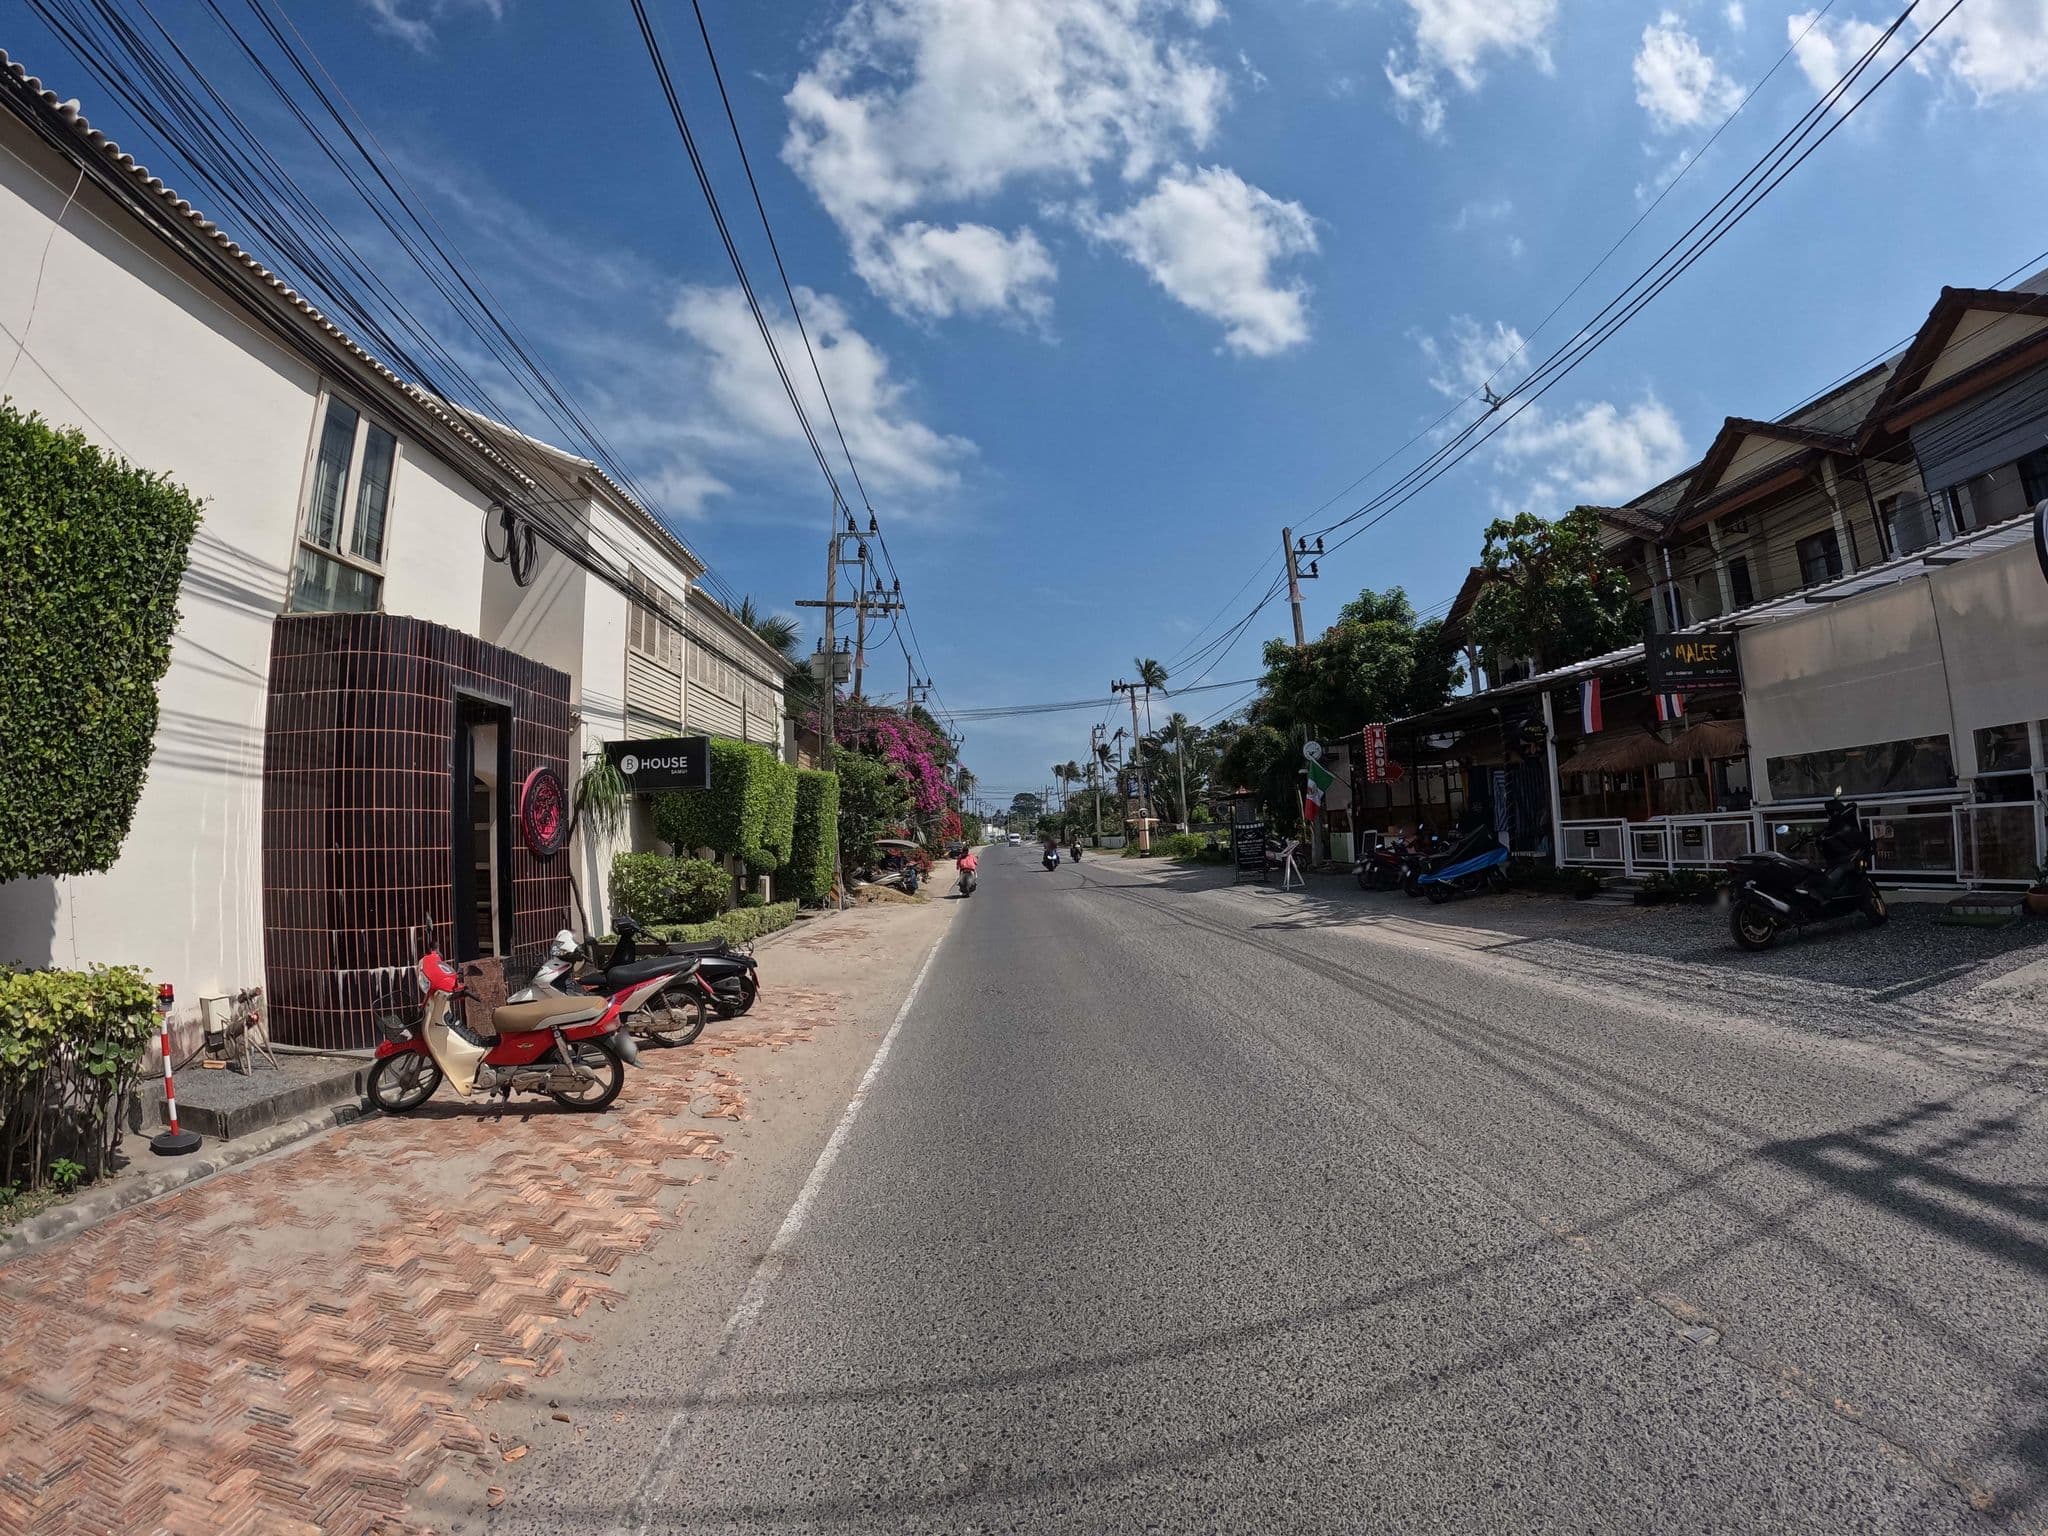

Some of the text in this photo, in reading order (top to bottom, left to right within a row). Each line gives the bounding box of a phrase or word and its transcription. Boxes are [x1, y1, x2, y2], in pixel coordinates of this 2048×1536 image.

[1675, 642, 1718, 663] MALEE
[641, 756, 688, 769] HOUSE
[1373, 727, 1385, 777] TACOS
